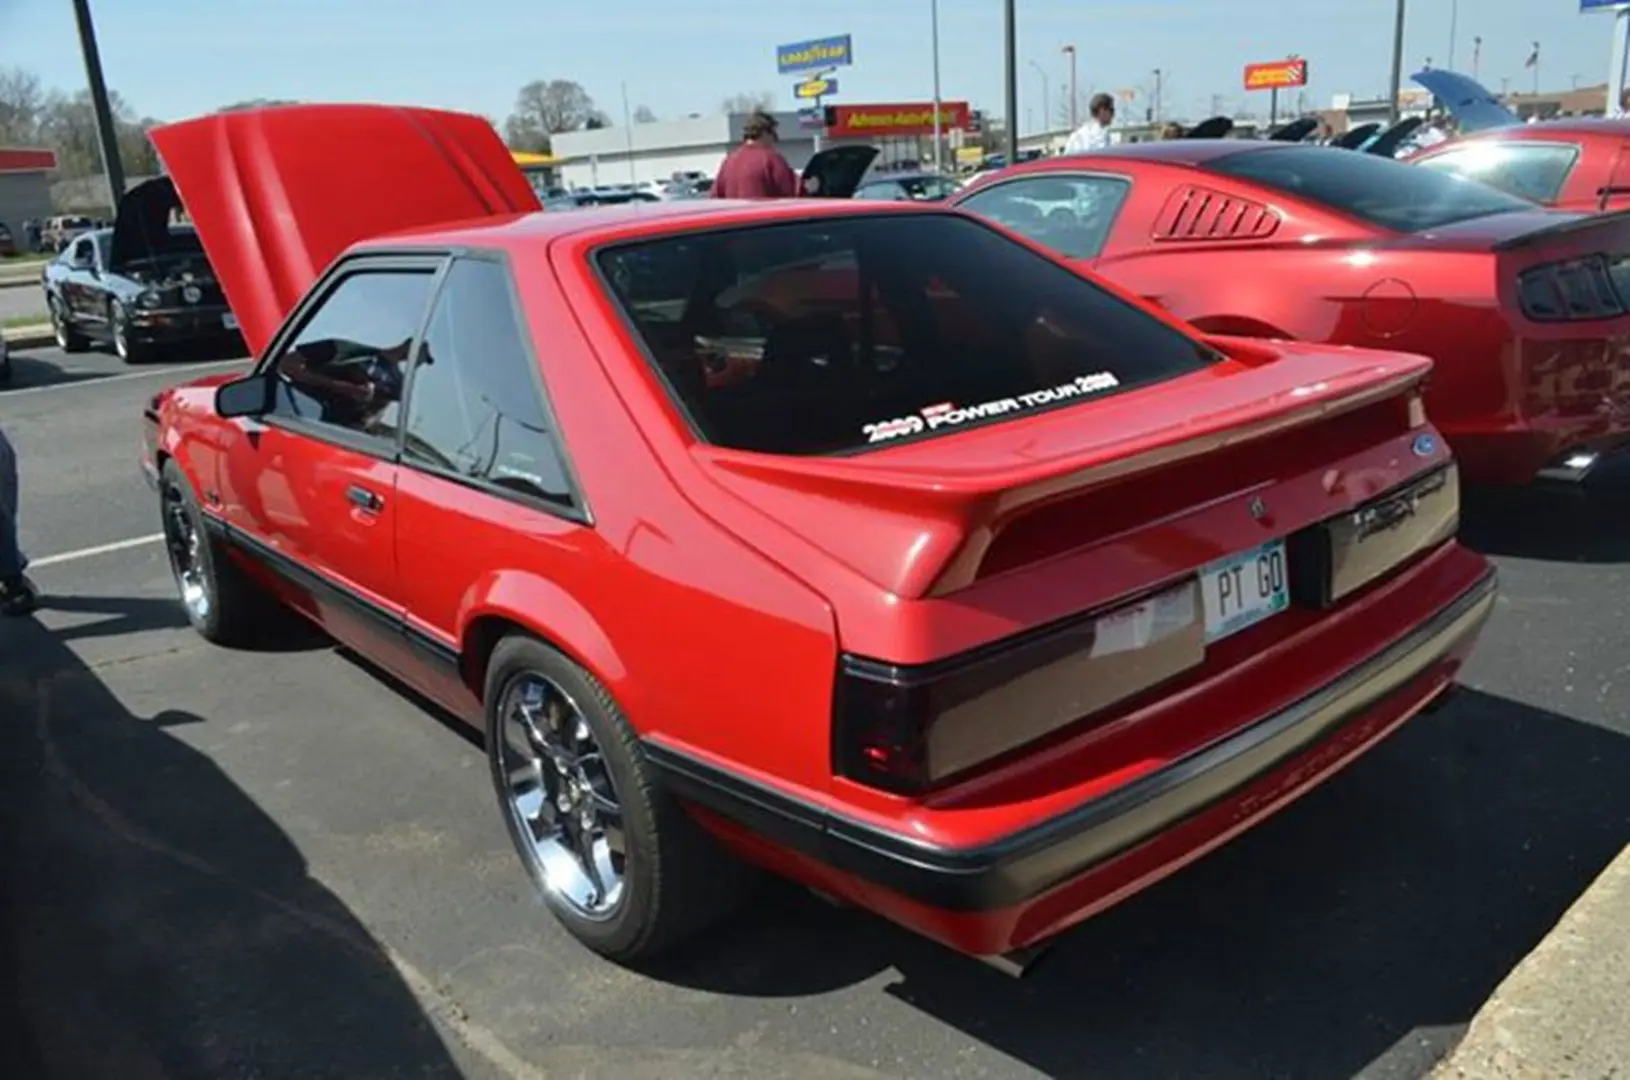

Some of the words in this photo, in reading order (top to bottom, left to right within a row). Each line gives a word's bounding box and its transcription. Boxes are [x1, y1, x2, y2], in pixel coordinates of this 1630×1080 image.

[862, 415, 924, 443] 2009
[925, 397, 1020, 429] POWER
[1018, 382, 1080, 408] TOUR
[1217, 564, 1244, 617] PT
